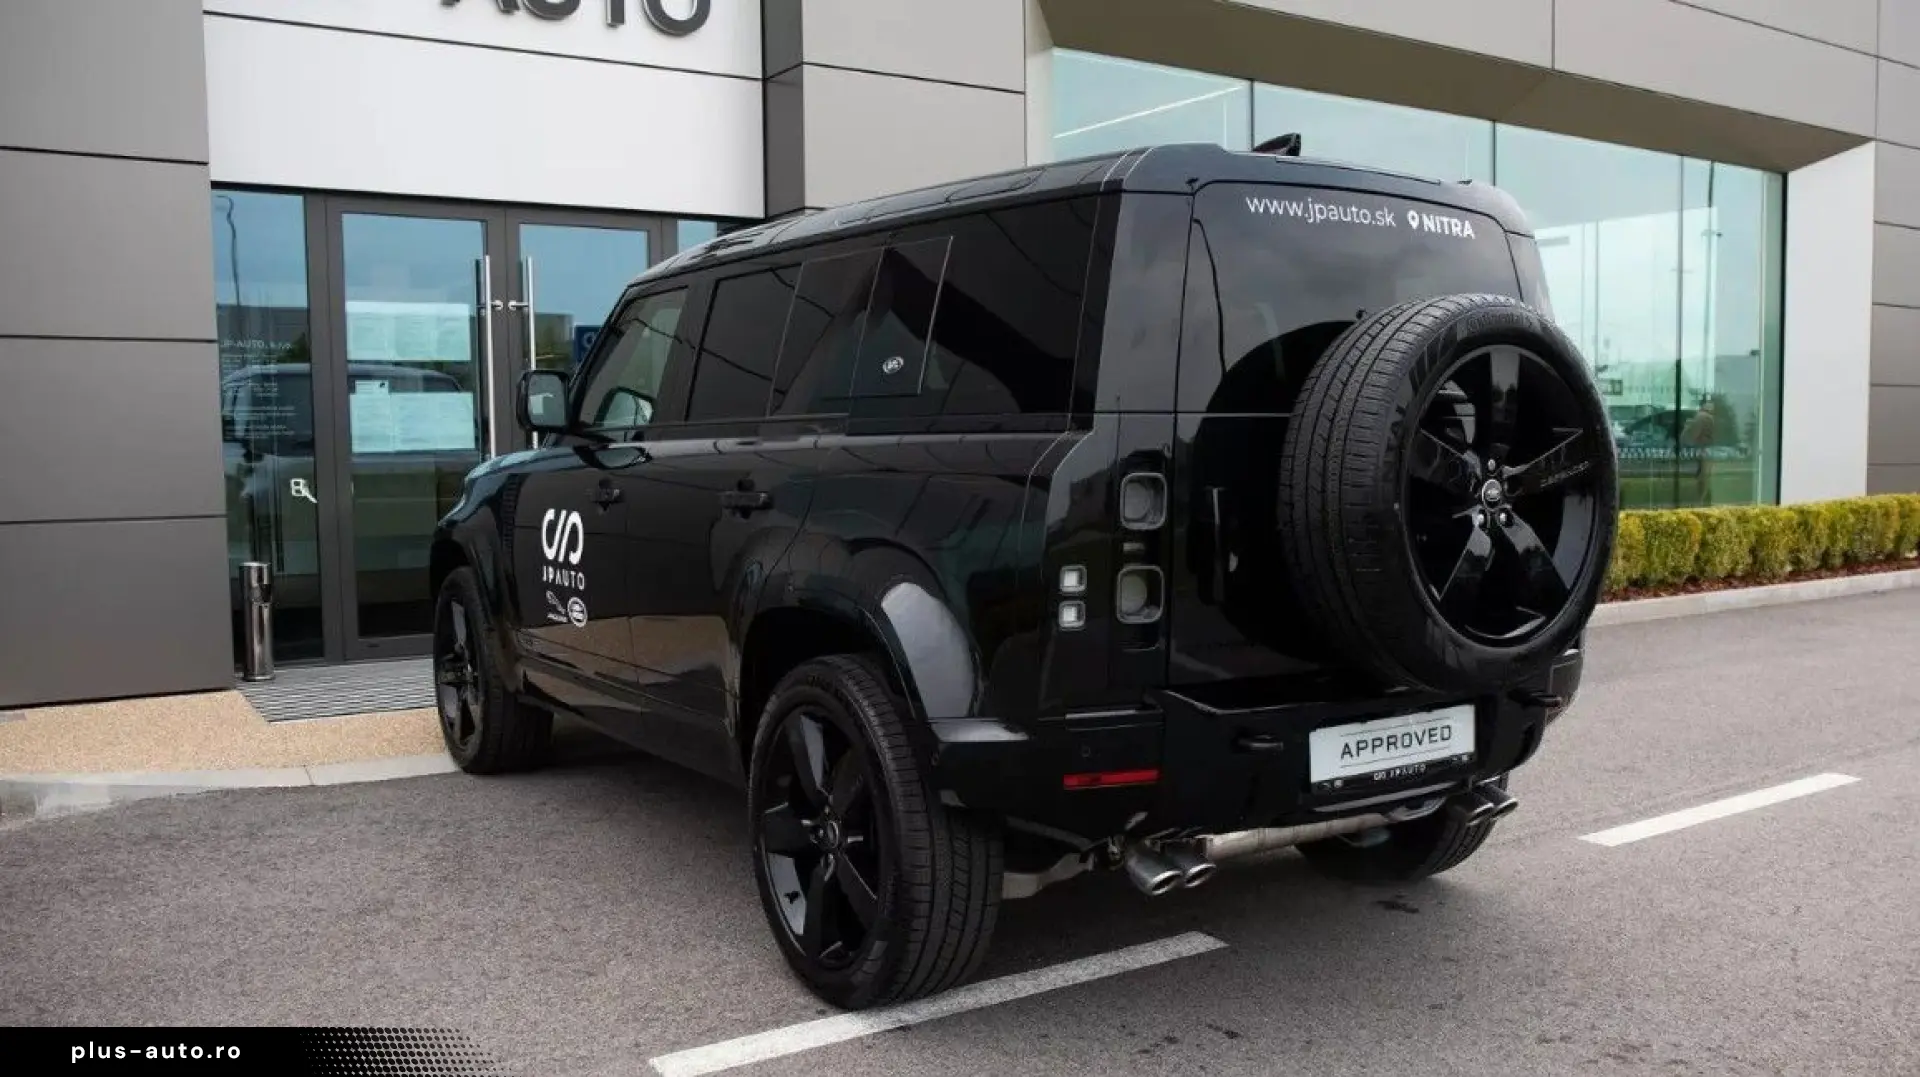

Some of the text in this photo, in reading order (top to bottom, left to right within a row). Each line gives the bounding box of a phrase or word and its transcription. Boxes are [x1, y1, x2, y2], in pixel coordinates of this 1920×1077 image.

[1246, 197, 1475, 239] www.jpauto.sk NITRA
[1340, 725, 1452, 761] APPROVED
